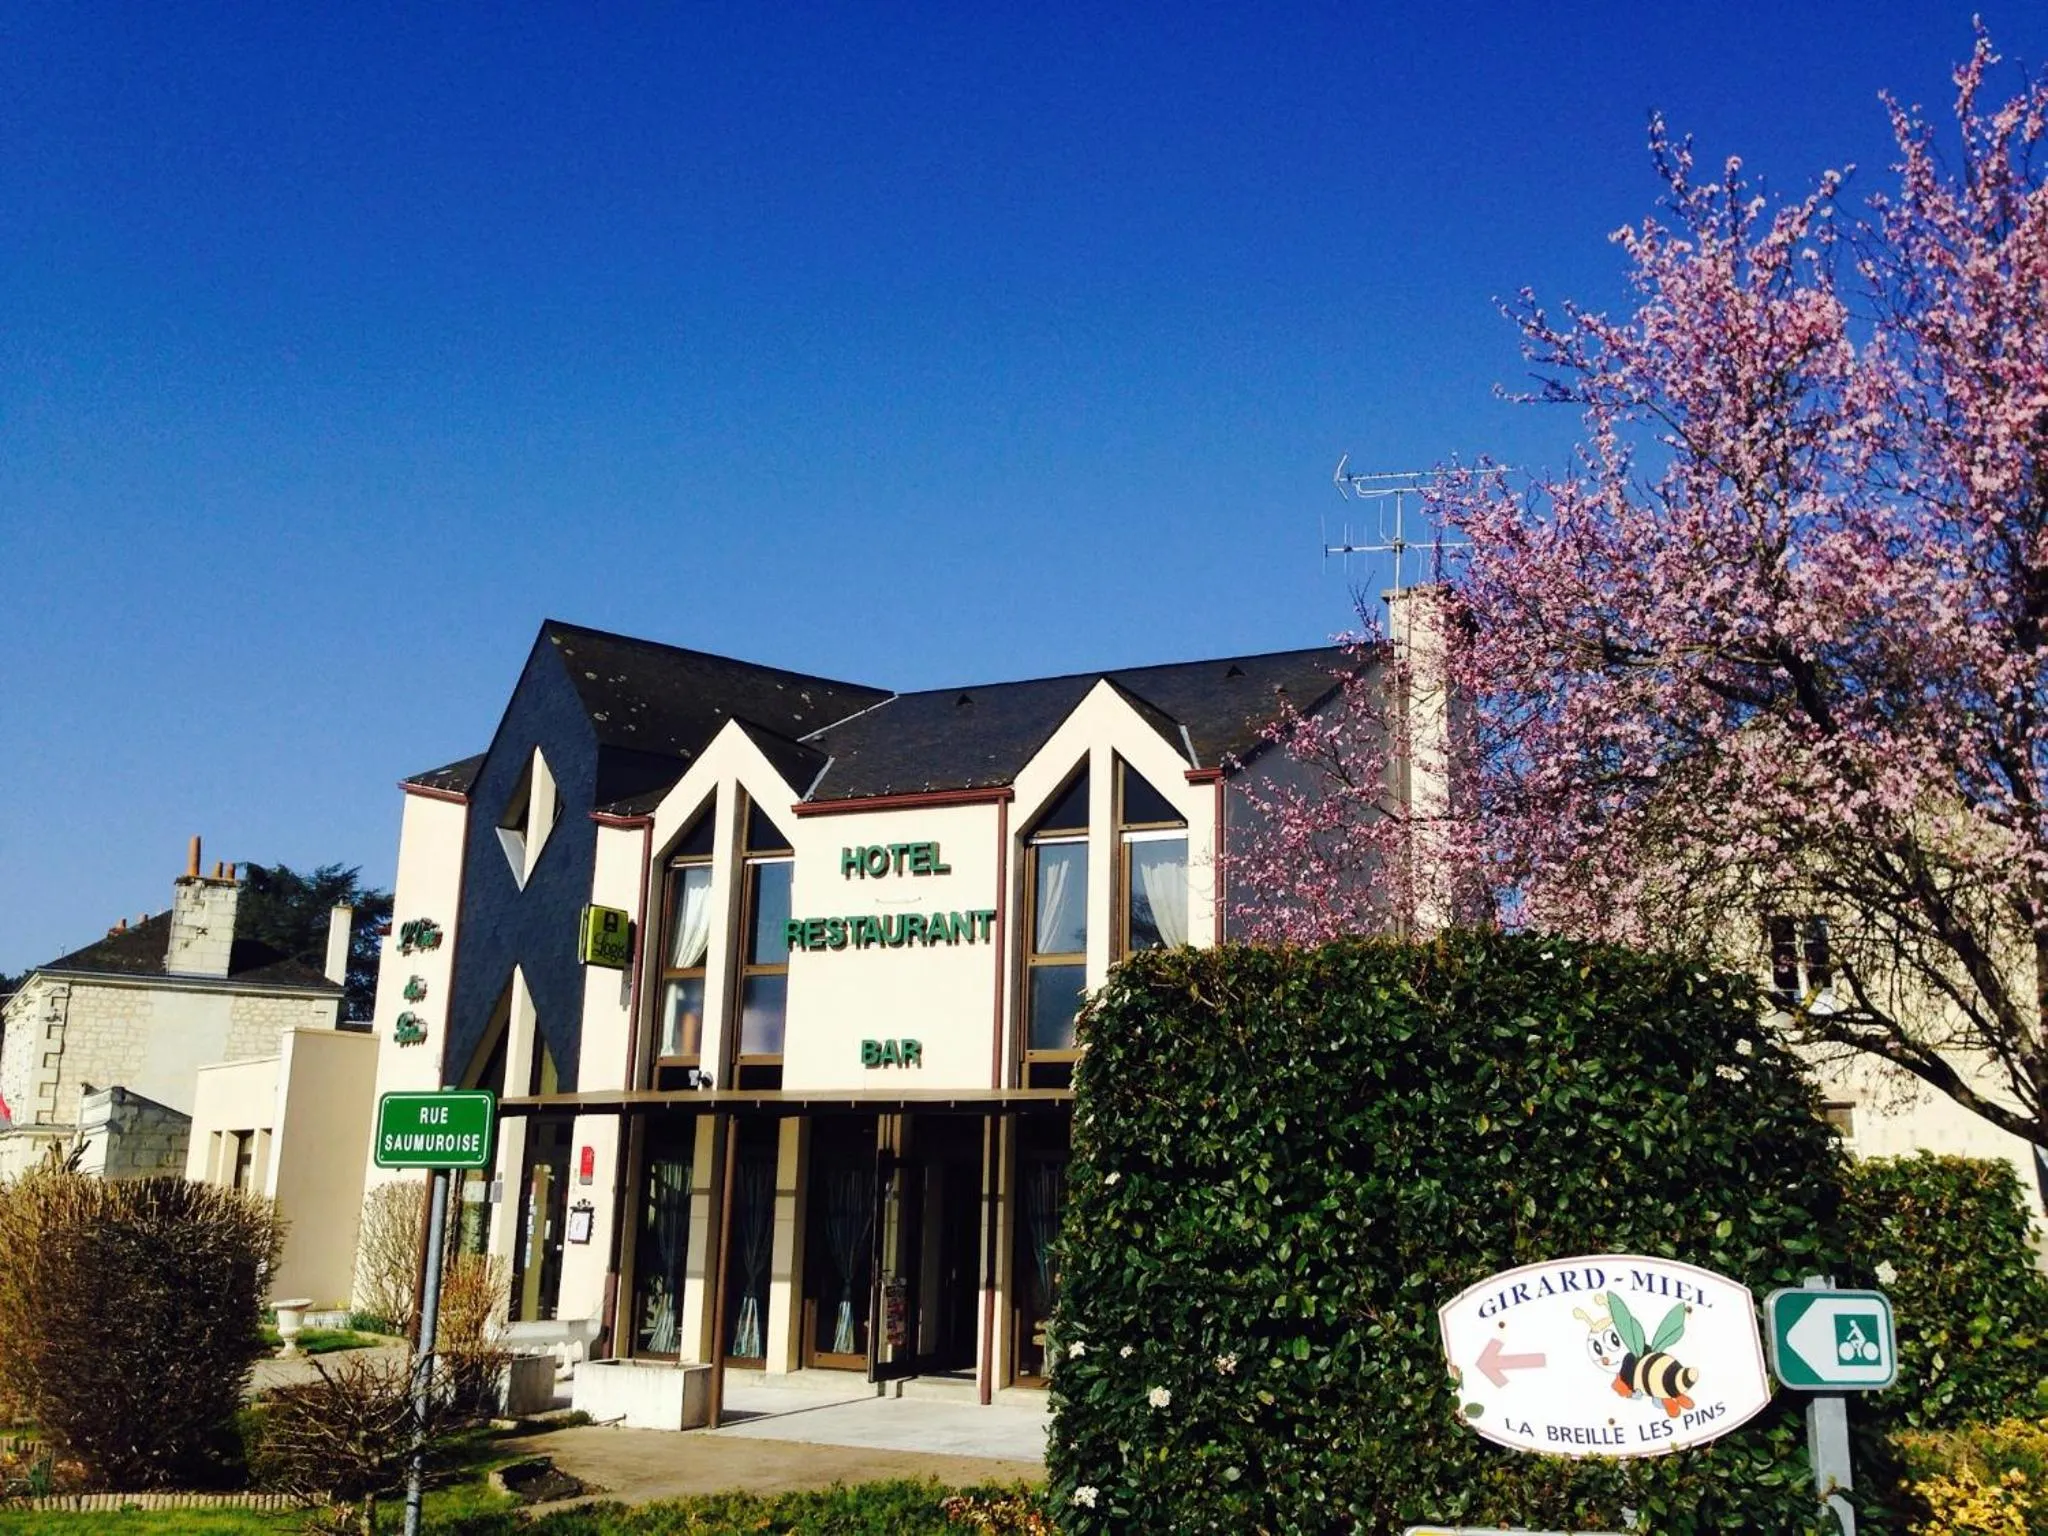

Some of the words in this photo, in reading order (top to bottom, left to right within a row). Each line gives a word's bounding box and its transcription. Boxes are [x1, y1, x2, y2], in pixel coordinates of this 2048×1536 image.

[841, 841, 951, 879] HOTEL
[784, 909, 996, 951] RESTAURANT
[861, 1039, 922, 1069] BAR
[420, 1106, 449, 1124] RUE
[384, 1133, 481, 1152] SAUMUROISE
[1504, 1417, 1535, 1438] LA
[1546, 1425, 1626, 1445] BREILLE
[1639, 1419, 1674, 1442] LES
[1684, 1401, 1727, 1431] PINS
